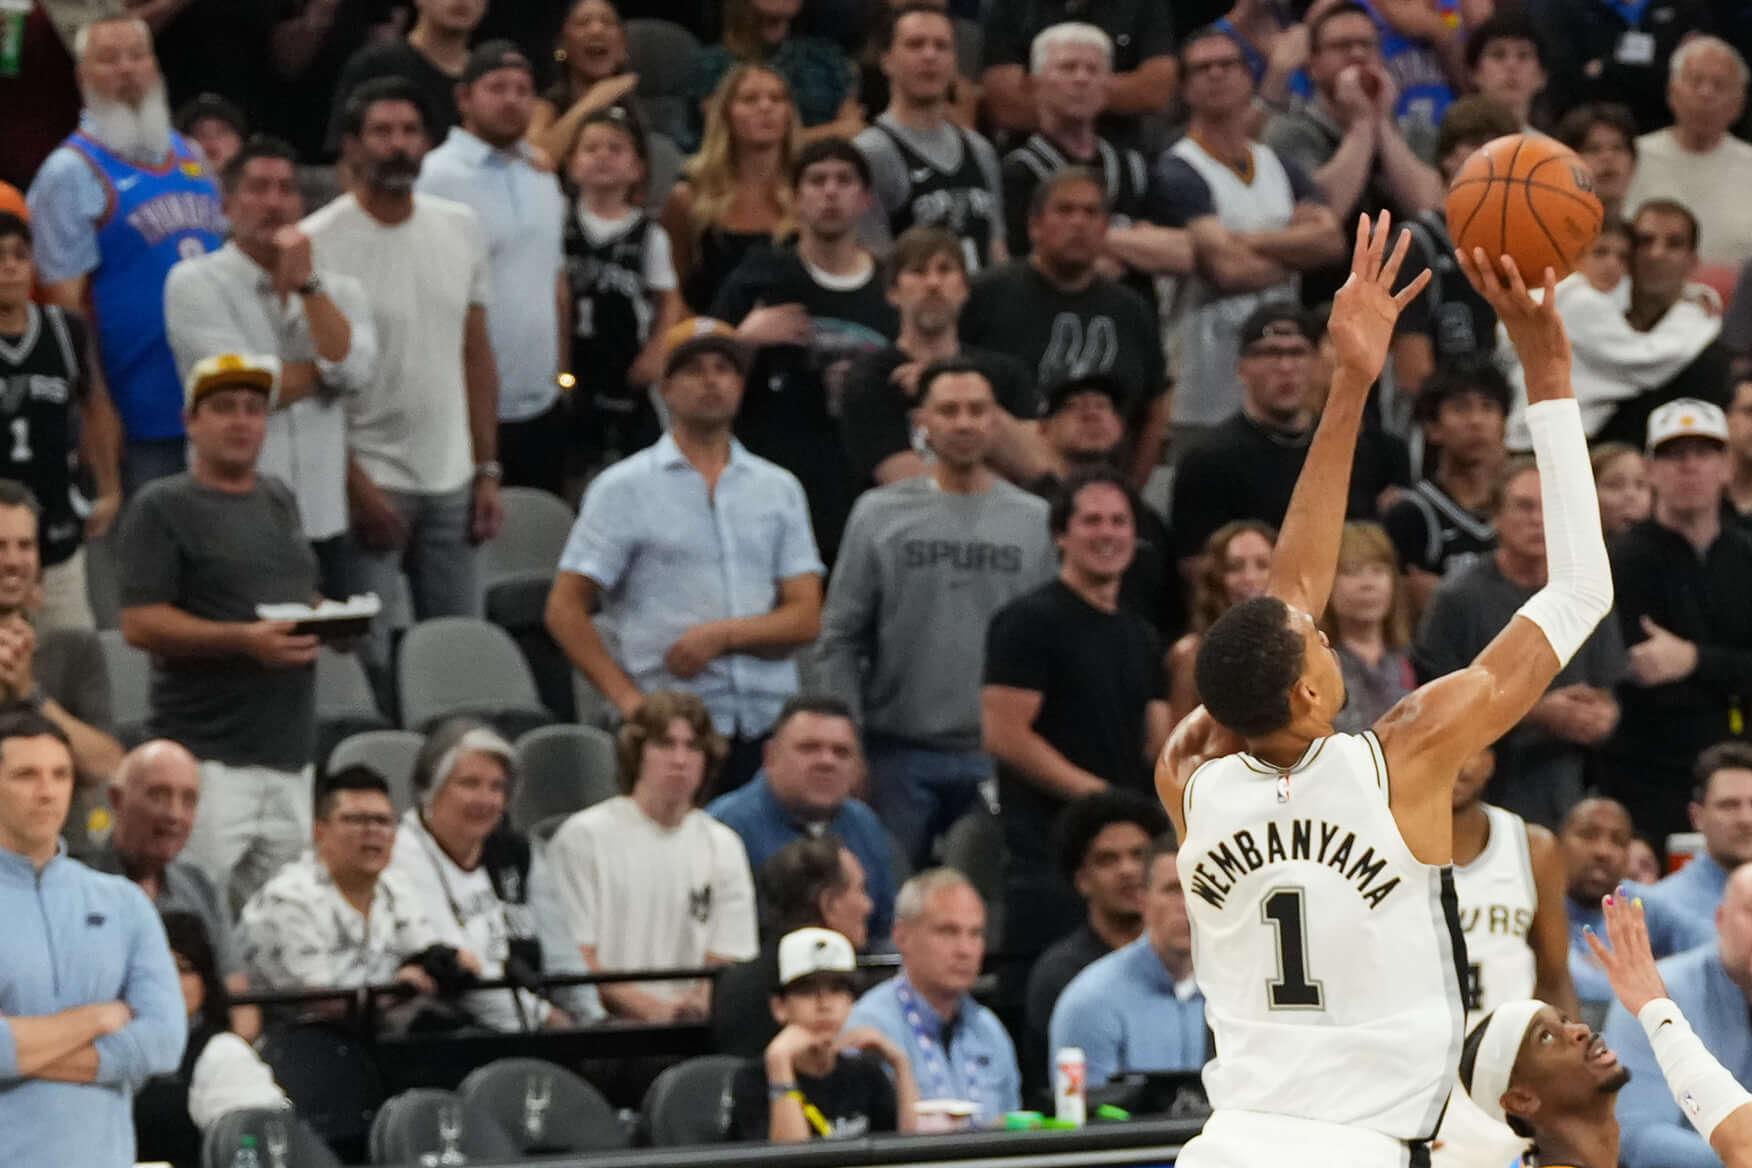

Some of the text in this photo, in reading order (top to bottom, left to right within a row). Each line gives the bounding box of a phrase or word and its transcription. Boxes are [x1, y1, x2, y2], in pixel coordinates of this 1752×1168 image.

[11, 418, 32, 461] 1
[903, 540, 1022, 573] SPURS
[1191, 819, 1402, 911] WEMBANYAMA
[1261, 886, 1325, 1011] 1
